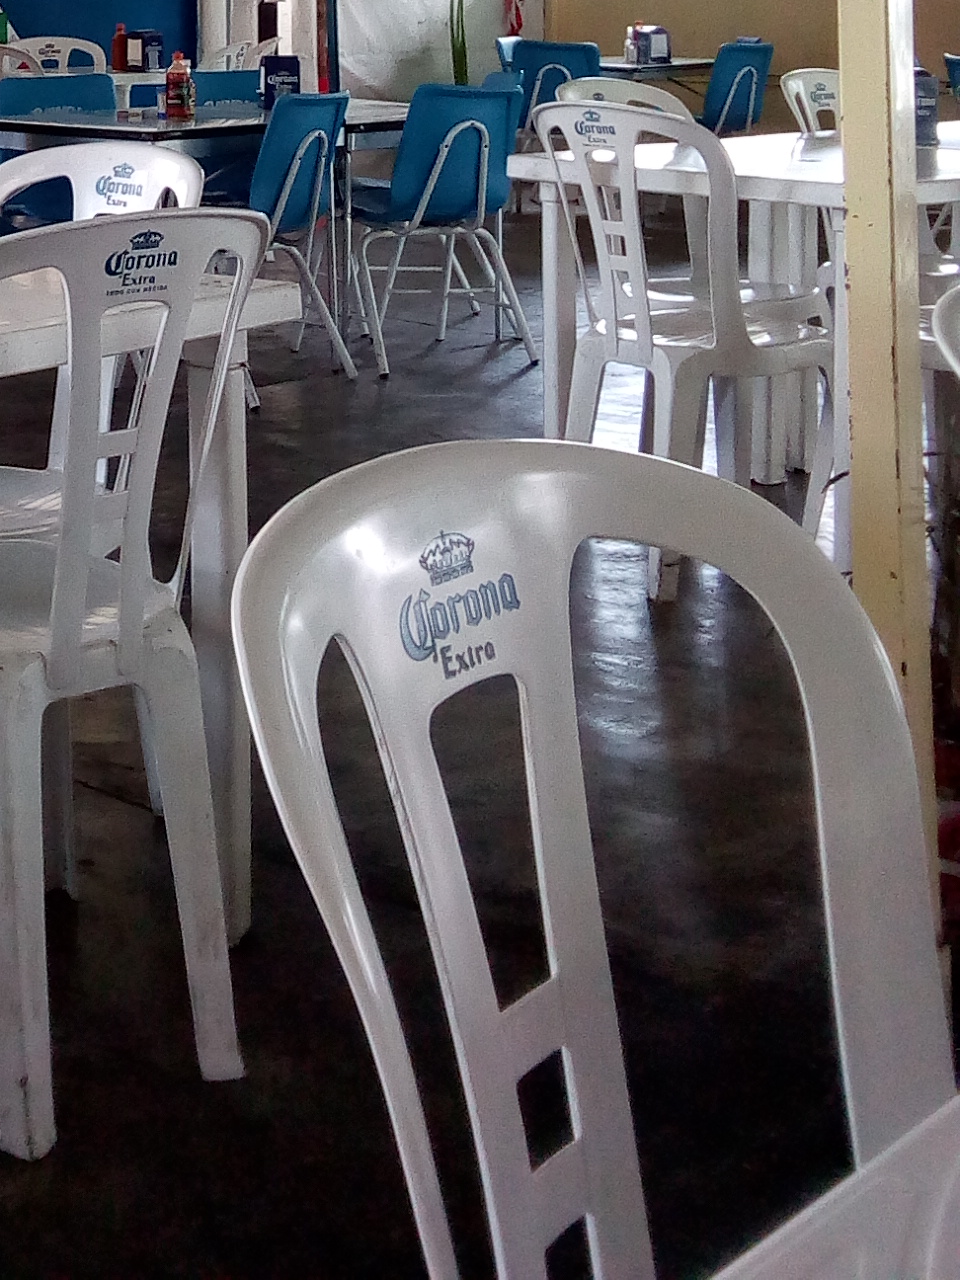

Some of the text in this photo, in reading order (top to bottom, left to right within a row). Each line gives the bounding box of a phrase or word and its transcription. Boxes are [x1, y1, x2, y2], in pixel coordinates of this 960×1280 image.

[574, 120, 616, 137] Corona
[95, 175, 144, 198] Corona
[104, 249, 178, 279] Corona
[121, 272, 156, 287] Extra
[399, 572, 522, 664] Corona
[440, 641, 497, 680] Extra
